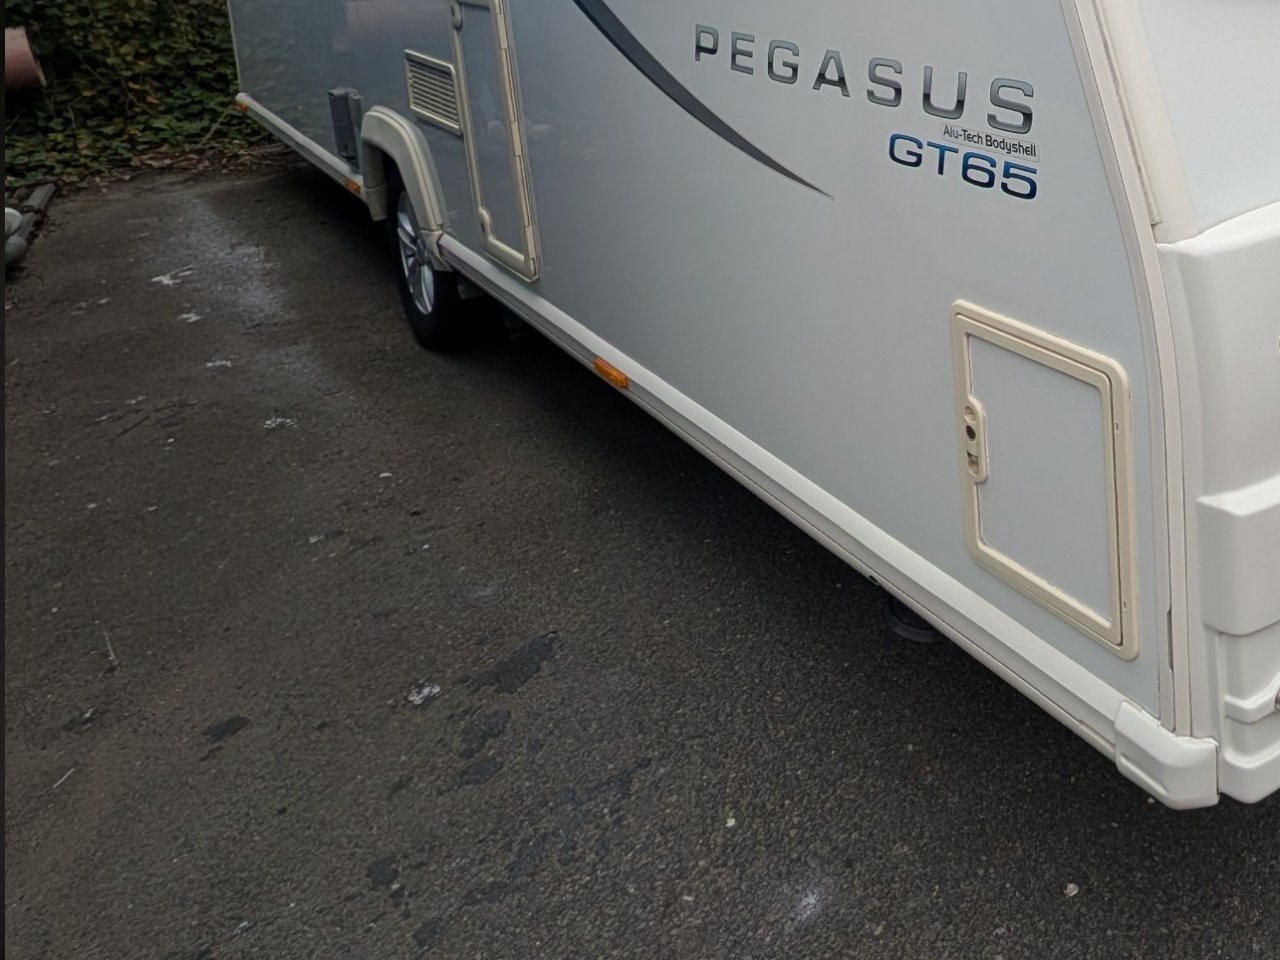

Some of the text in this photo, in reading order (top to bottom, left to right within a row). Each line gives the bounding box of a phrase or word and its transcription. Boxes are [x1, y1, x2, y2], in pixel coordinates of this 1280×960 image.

[694, 23, 1035, 135] PEGASUS
[888, 133, 1038, 200] GT65
[943, 124, 1037, 157] Alu-Tech Bodyshell
